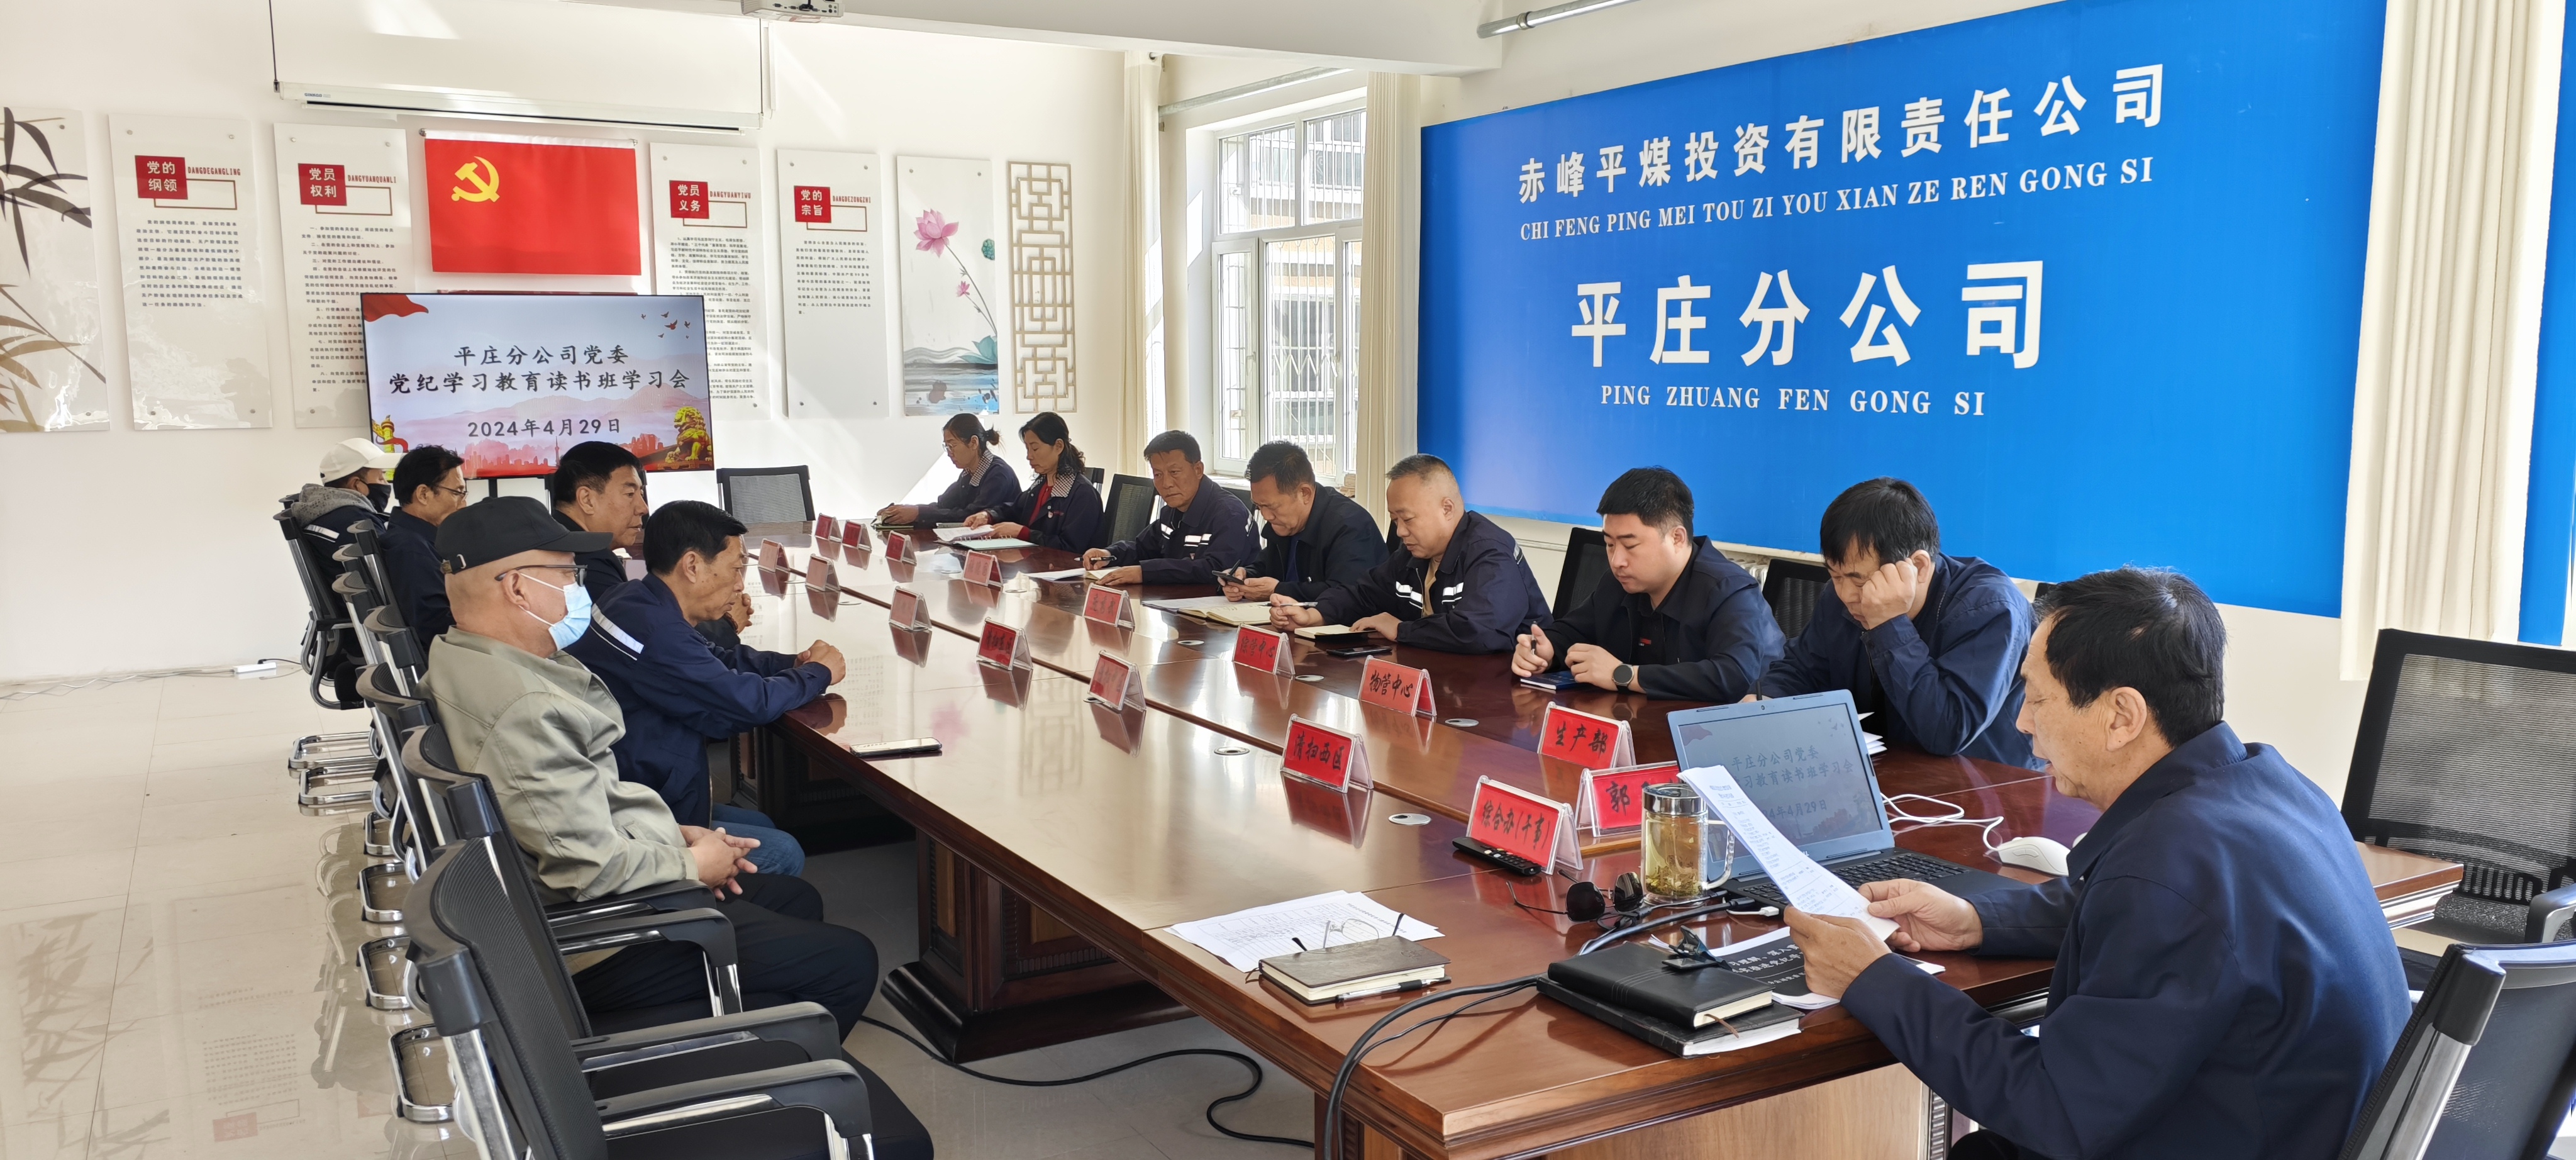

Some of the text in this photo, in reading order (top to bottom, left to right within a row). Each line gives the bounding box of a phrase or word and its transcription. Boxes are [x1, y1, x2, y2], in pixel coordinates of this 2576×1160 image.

[1519, 64, 2163, 204] 赤峰平煤投资有限责任公司
[147, 160, 175, 174] 党的
[187, 166, 241, 176] DANGDEGANGLING
[309, 167, 336, 181] 党员
[148, 178, 177, 192] 纲领
[348, 174, 396, 184] DANGYUANQUANLI
[310, 184, 337, 198] 权利
[677, 184, 700, 196] 党员
[709, 191, 752, 199] DANGYUANYIWU
[801, 189, 823, 201] 党的
[679, 199, 701, 212] 义务
[832, 195, 871, 204] DANGDEZONGZHI
[1521, 157, 2153, 240] CHI FENG PING MEI TOU ZI YOU XIAN ZE REN GONG SI
[801, 204, 823, 216] 宗旨
[1571, 260, 2043, 369] 平庄分公司
[453, 345, 629, 367] 平庄分公司党委
[389, 369, 690, 394] 党纪学习教育读书班学习会
[1601, 385, 1985, 416] PING ZHUANG FEN GONG SI
[467, 418, 620, 438] 2024年4月29日
[1368, 669, 1414, 701] 物管中心
[1555, 720, 1609, 760] 生产部
[1293, 730, 1345, 771] 清扫西区
[1731, 745, 1819, 772] 平庄分公司党委
